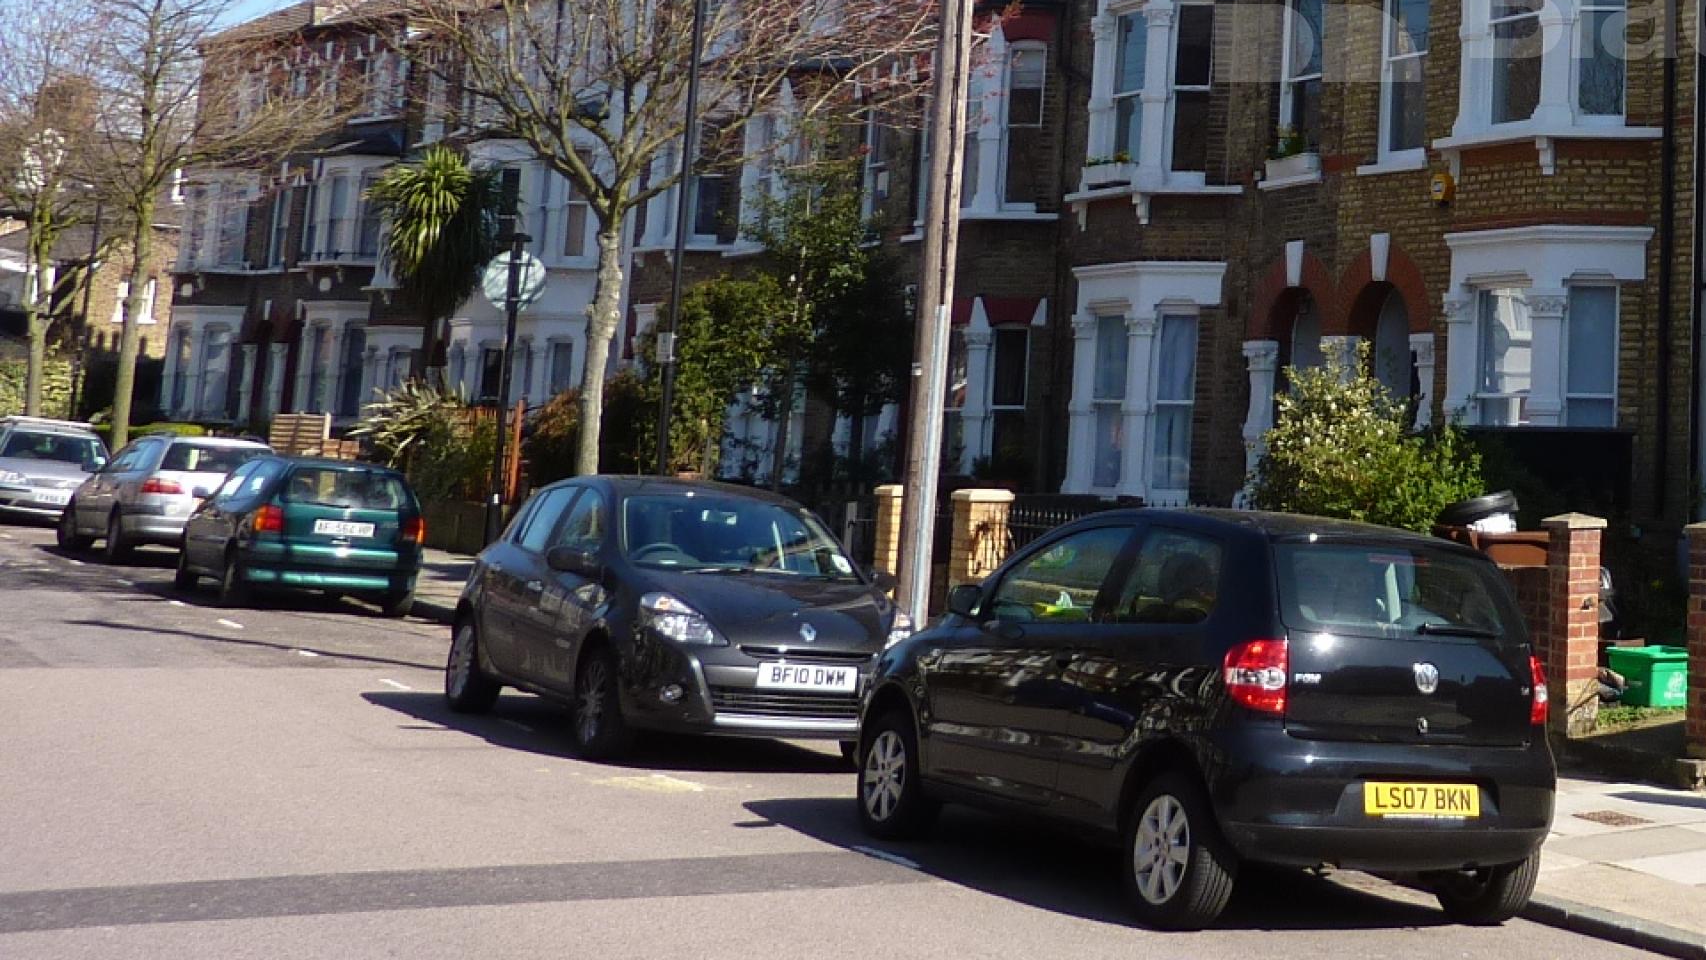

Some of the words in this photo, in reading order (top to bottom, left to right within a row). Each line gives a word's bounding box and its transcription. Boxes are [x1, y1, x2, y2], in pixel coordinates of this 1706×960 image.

[771, 666, 810, 684] BF10
[813, 670, 847, 686] DWM
[1375, 785, 1428, 810] LS07
[1433, 787, 1471, 812] BKN
